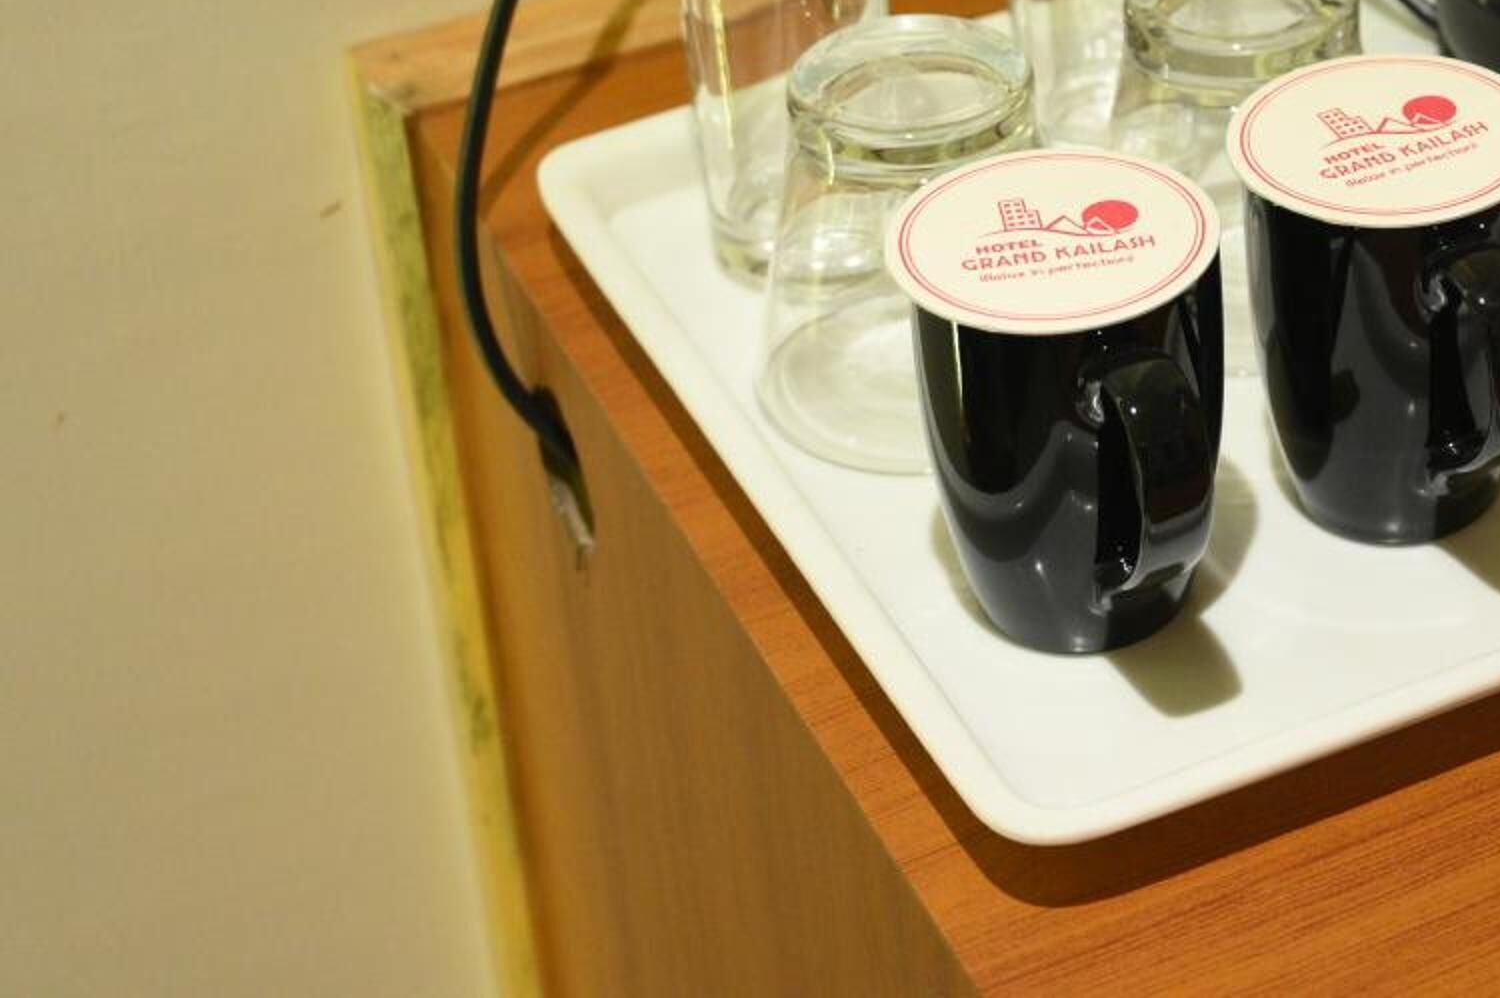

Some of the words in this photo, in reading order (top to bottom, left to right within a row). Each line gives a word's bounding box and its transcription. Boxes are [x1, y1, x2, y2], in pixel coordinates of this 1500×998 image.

[1320, 152, 1395, 180] GRAND
[1399, 120, 1489, 157] KAILASH
[1324, 142, 1386, 165] HOTEL
[961, 250, 1047, 271] GRAND
[1055, 235, 1156, 260] KAILASH
[975, 239, 1044, 254] HOTEL
